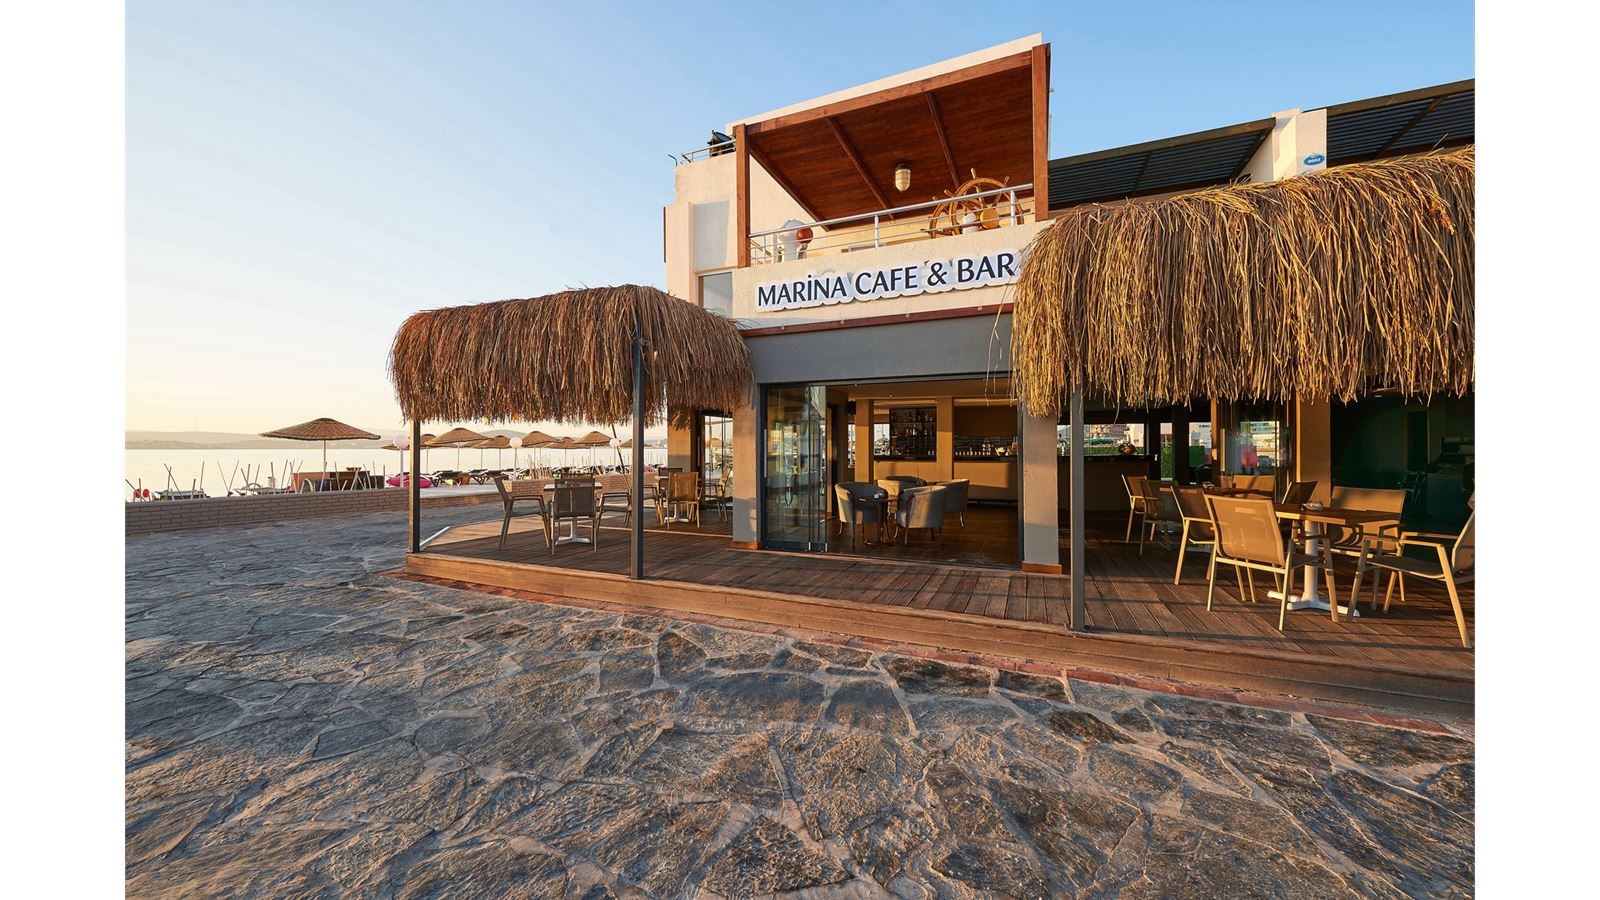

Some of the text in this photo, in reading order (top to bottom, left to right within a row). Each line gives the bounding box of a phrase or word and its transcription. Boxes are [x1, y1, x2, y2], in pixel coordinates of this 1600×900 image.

[758, 252, 1016, 307] MARİNA CAFE & BAR
